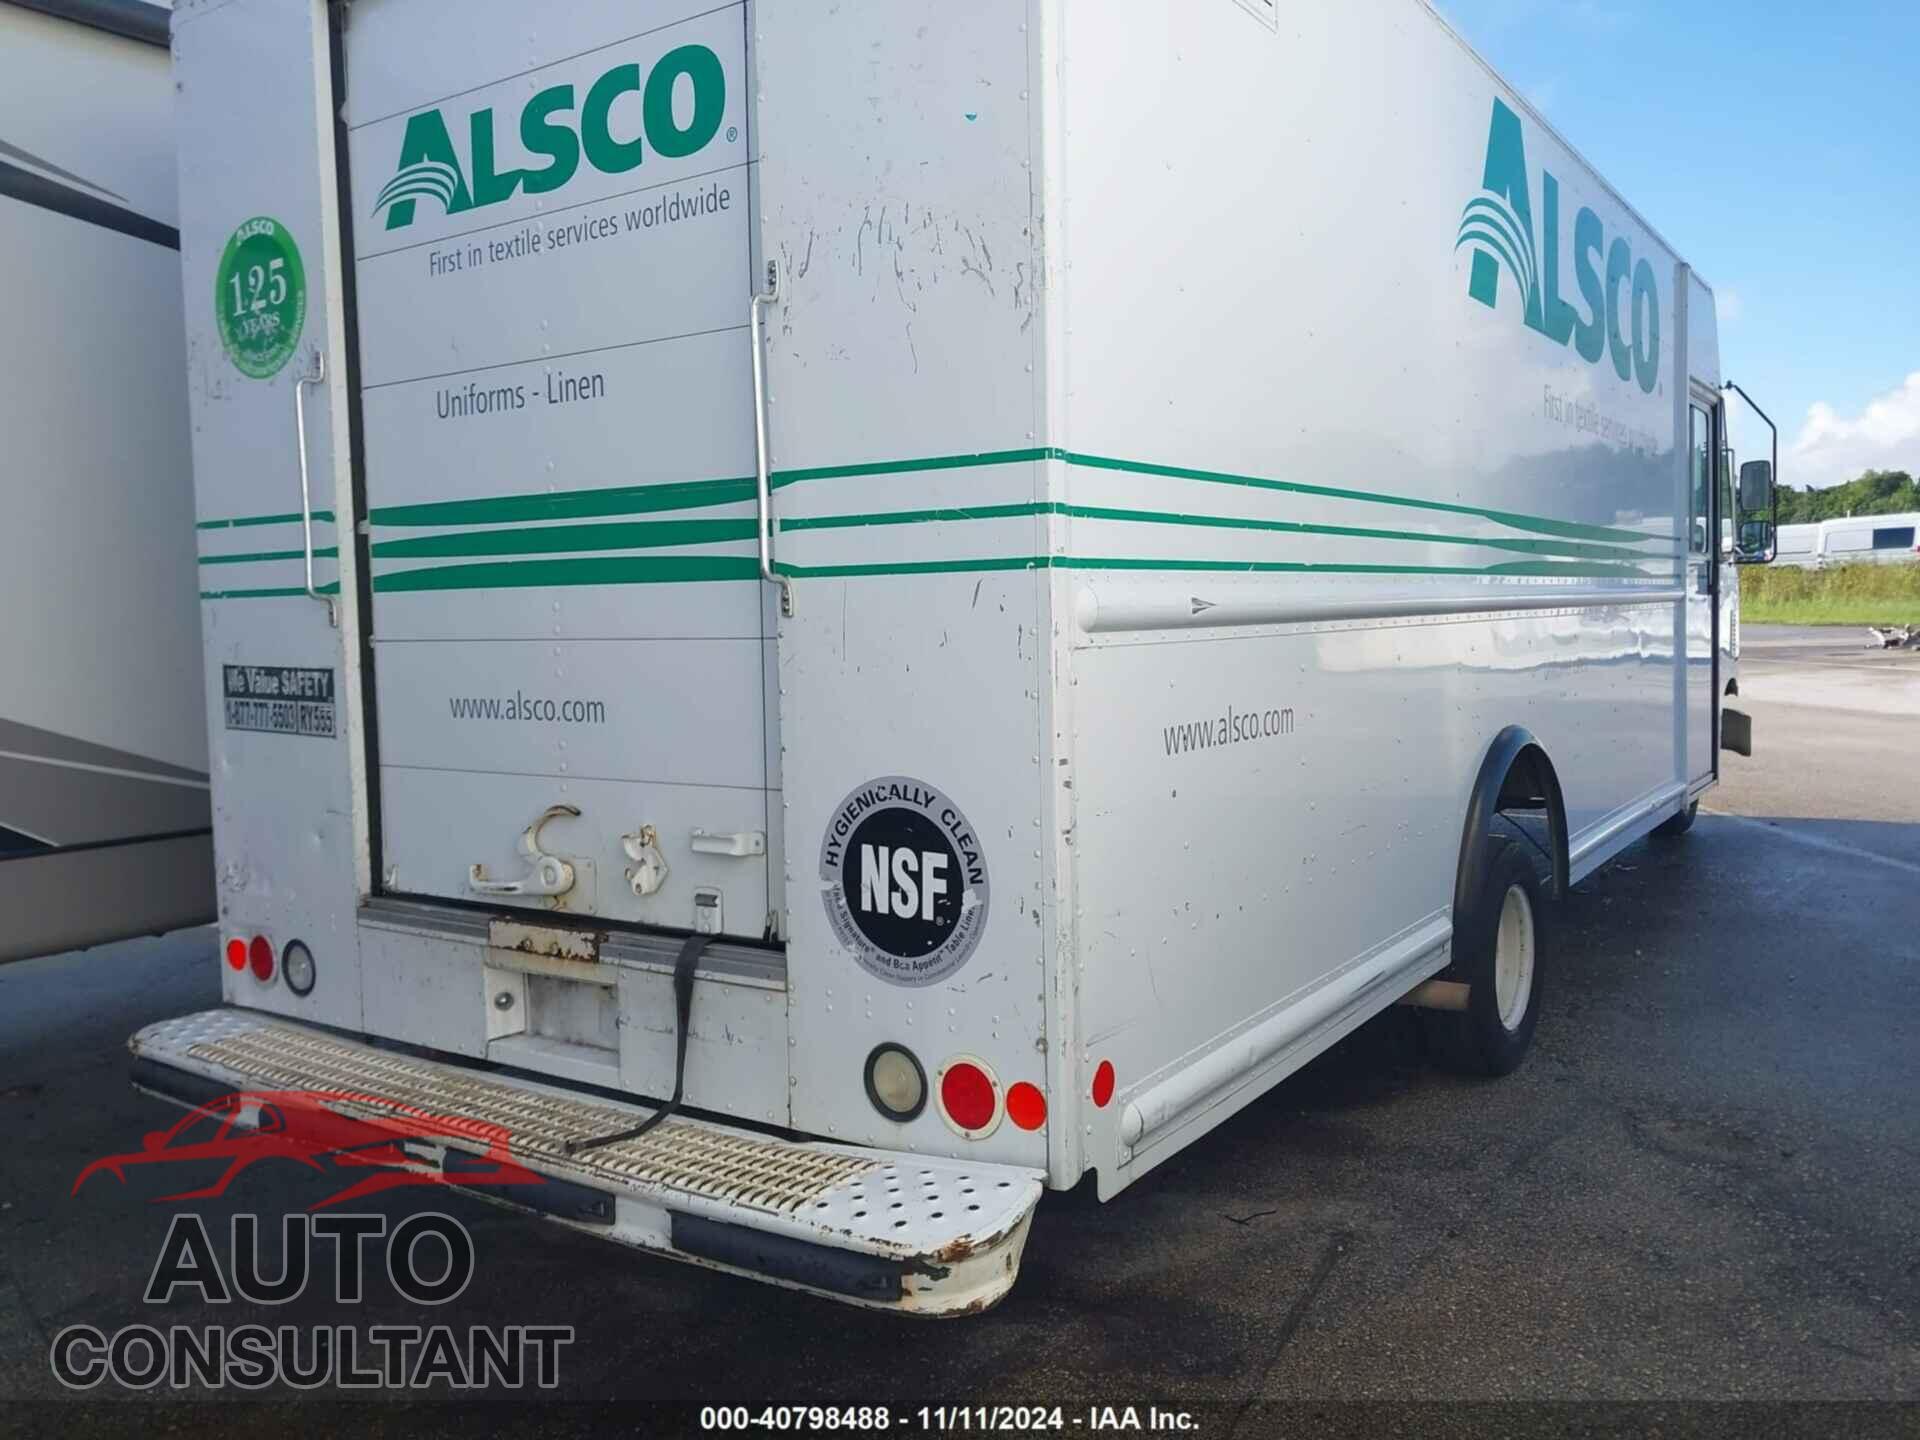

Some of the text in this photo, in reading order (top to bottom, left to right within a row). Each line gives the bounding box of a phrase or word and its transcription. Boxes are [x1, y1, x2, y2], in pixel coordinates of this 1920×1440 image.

[372, 44, 726, 231] ALSCO
[429, 183, 732, 278] First in textile services worldwide
[1455, 96, 1660, 394] ALSCO
[230, 257, 287, 317] 125
[436, 382, 526, 419] Uniforms
[547, 371, 605, 404] Linen
[245, 668, 280, 695] Value
[281, 669, 330, 697] SAFETY
[449, 689, 606, 724] www.alsco.com
[1163, 704, 1294, 756] www.alsco.com
[825, 783, 984, 886] HYGIENICALLY CLEAN
[860, 843, 948, 921] NSF
[945, 931, 965, 954] Table
